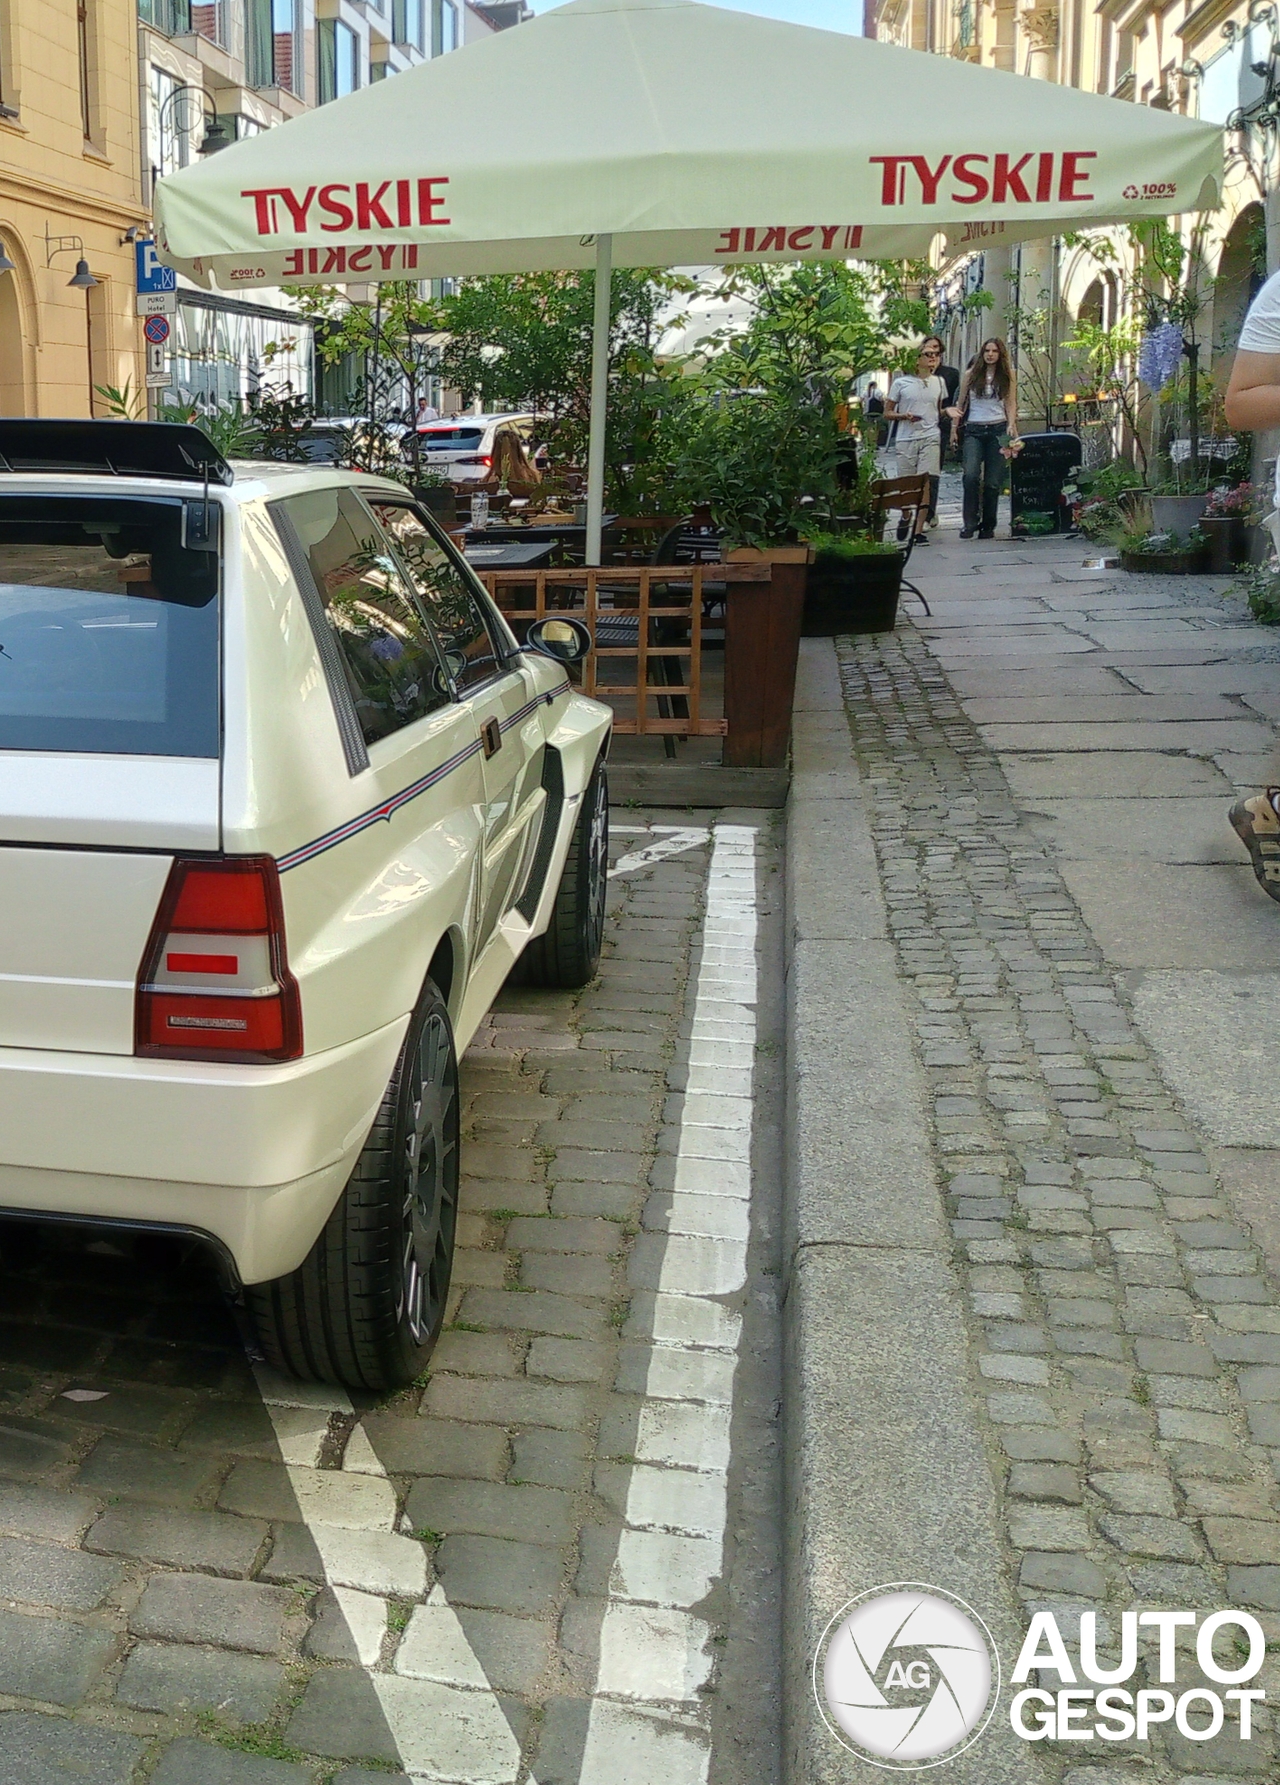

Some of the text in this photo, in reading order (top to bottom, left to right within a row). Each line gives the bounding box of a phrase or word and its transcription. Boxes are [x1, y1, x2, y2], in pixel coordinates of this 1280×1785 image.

[869, 151, 1097, 205] TYSKIE
[1142, 183, 1177, 194] 100%
[240, 177, 451, 235] TYSKIE
